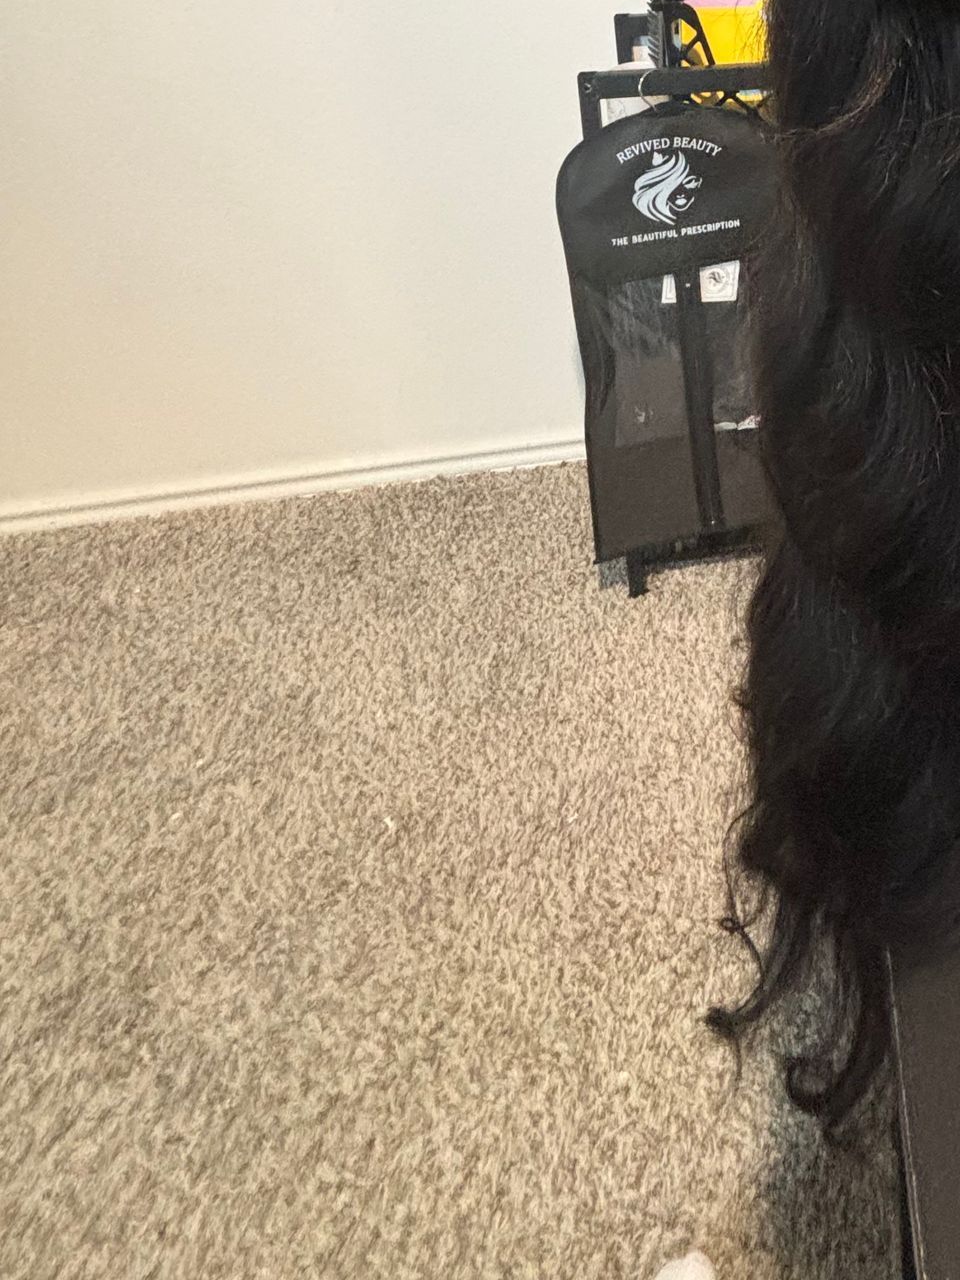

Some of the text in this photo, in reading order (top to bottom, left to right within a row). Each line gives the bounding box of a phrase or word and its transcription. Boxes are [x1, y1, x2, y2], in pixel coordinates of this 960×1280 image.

[615, 136, 722, 165] REVIVED BEAUTY
[611, 219, 741, 247] THE BEAUTIFUL PRESCRIPTION
